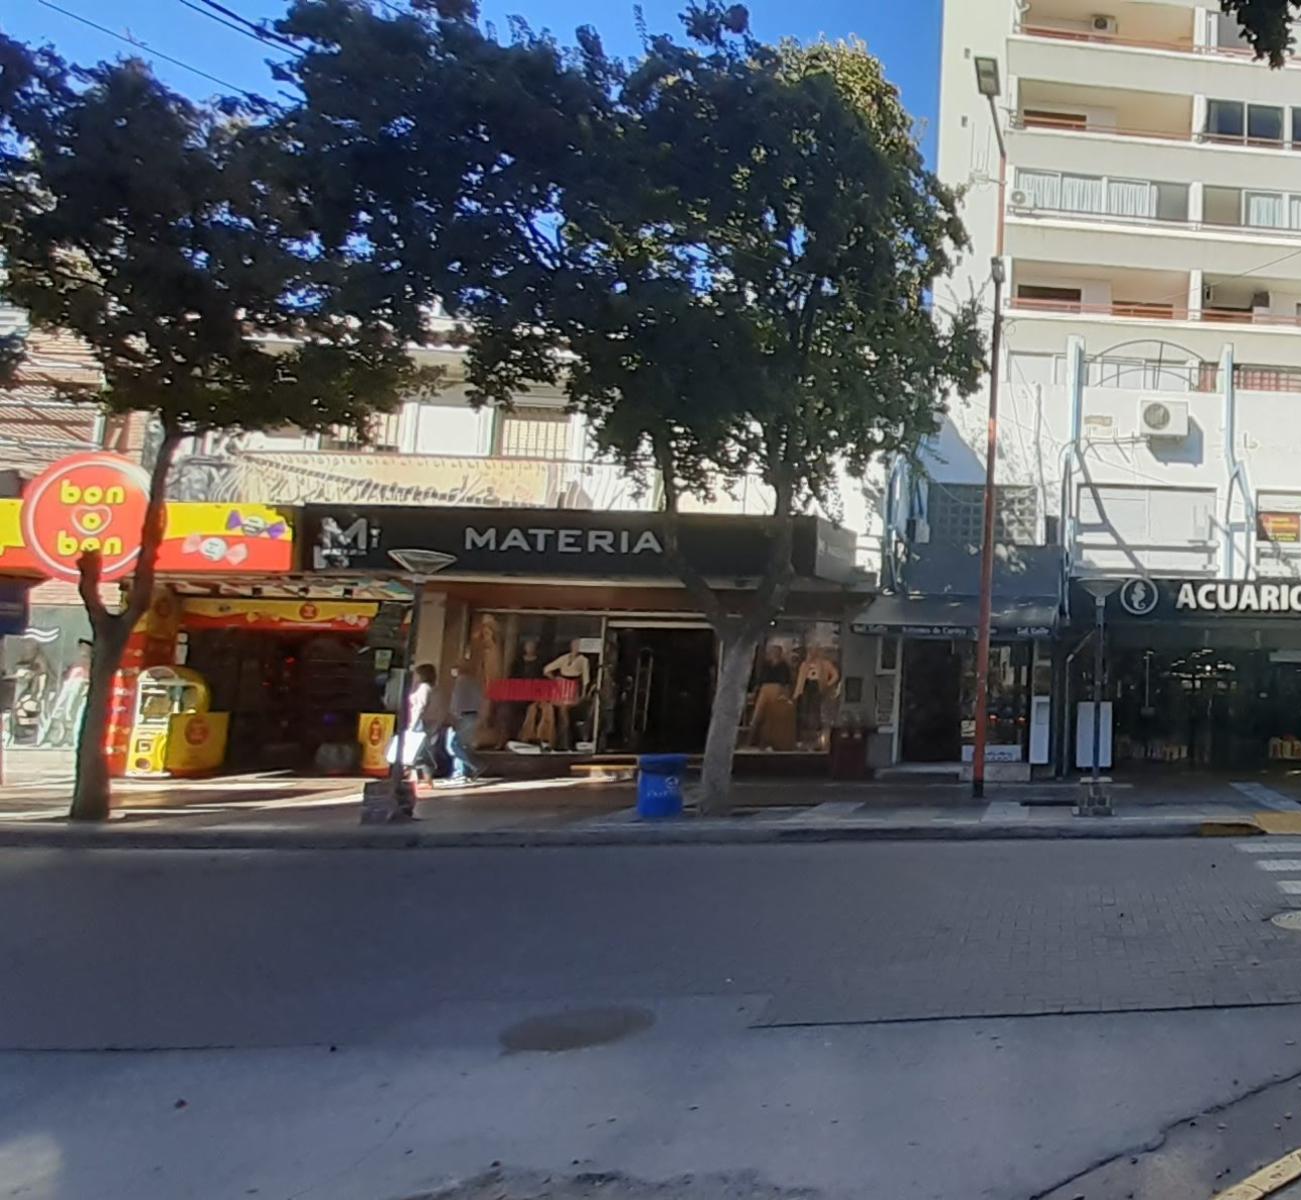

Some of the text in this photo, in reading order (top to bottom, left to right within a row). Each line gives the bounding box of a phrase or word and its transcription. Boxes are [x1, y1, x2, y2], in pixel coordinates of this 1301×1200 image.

[60, 479, 125, 504] bon
[82, 512, 101, 529] o
[57, 530, 122, 556] bon
[465, 527, 663, 554] MATERIA
